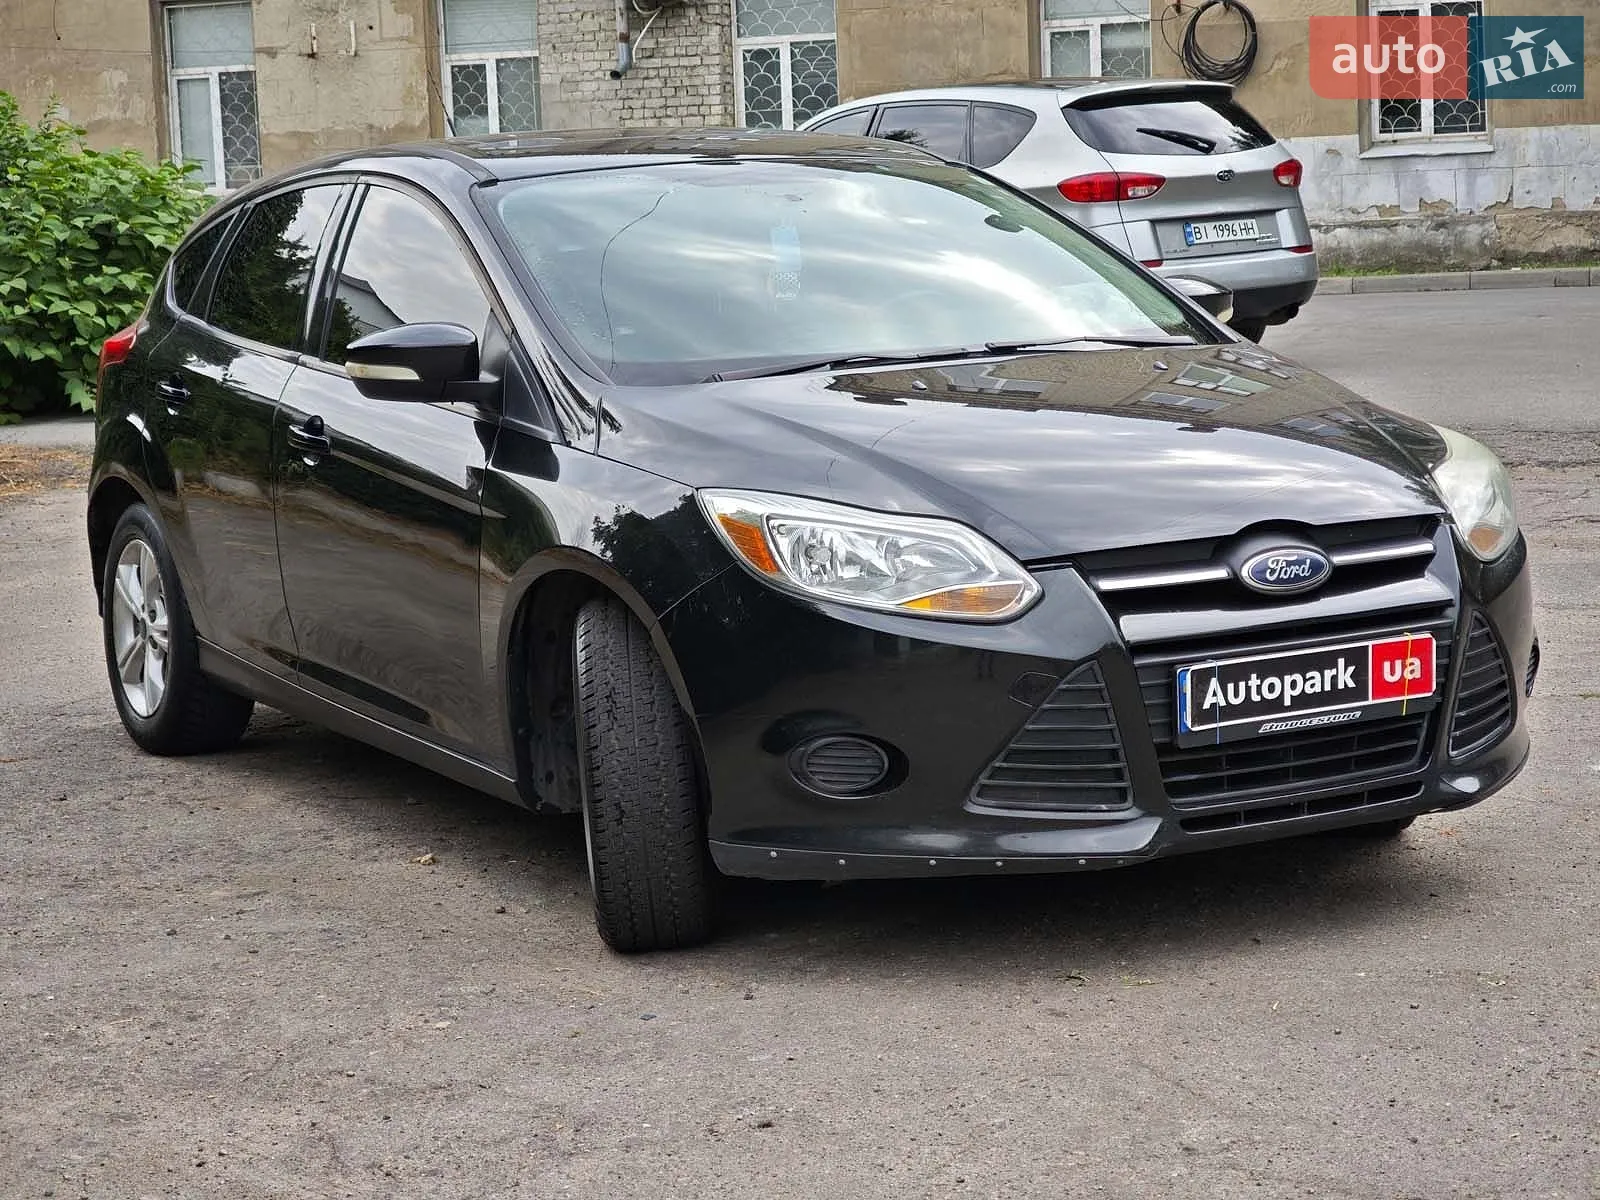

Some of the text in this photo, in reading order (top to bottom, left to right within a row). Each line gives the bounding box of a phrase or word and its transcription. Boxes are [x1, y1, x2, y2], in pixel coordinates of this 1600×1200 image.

[1193, 221, 1256, 240] BI 1996 HH
[1266, 554, 1312, 581] Ford
[1202, 656, 1422, 710] Autopark ua
